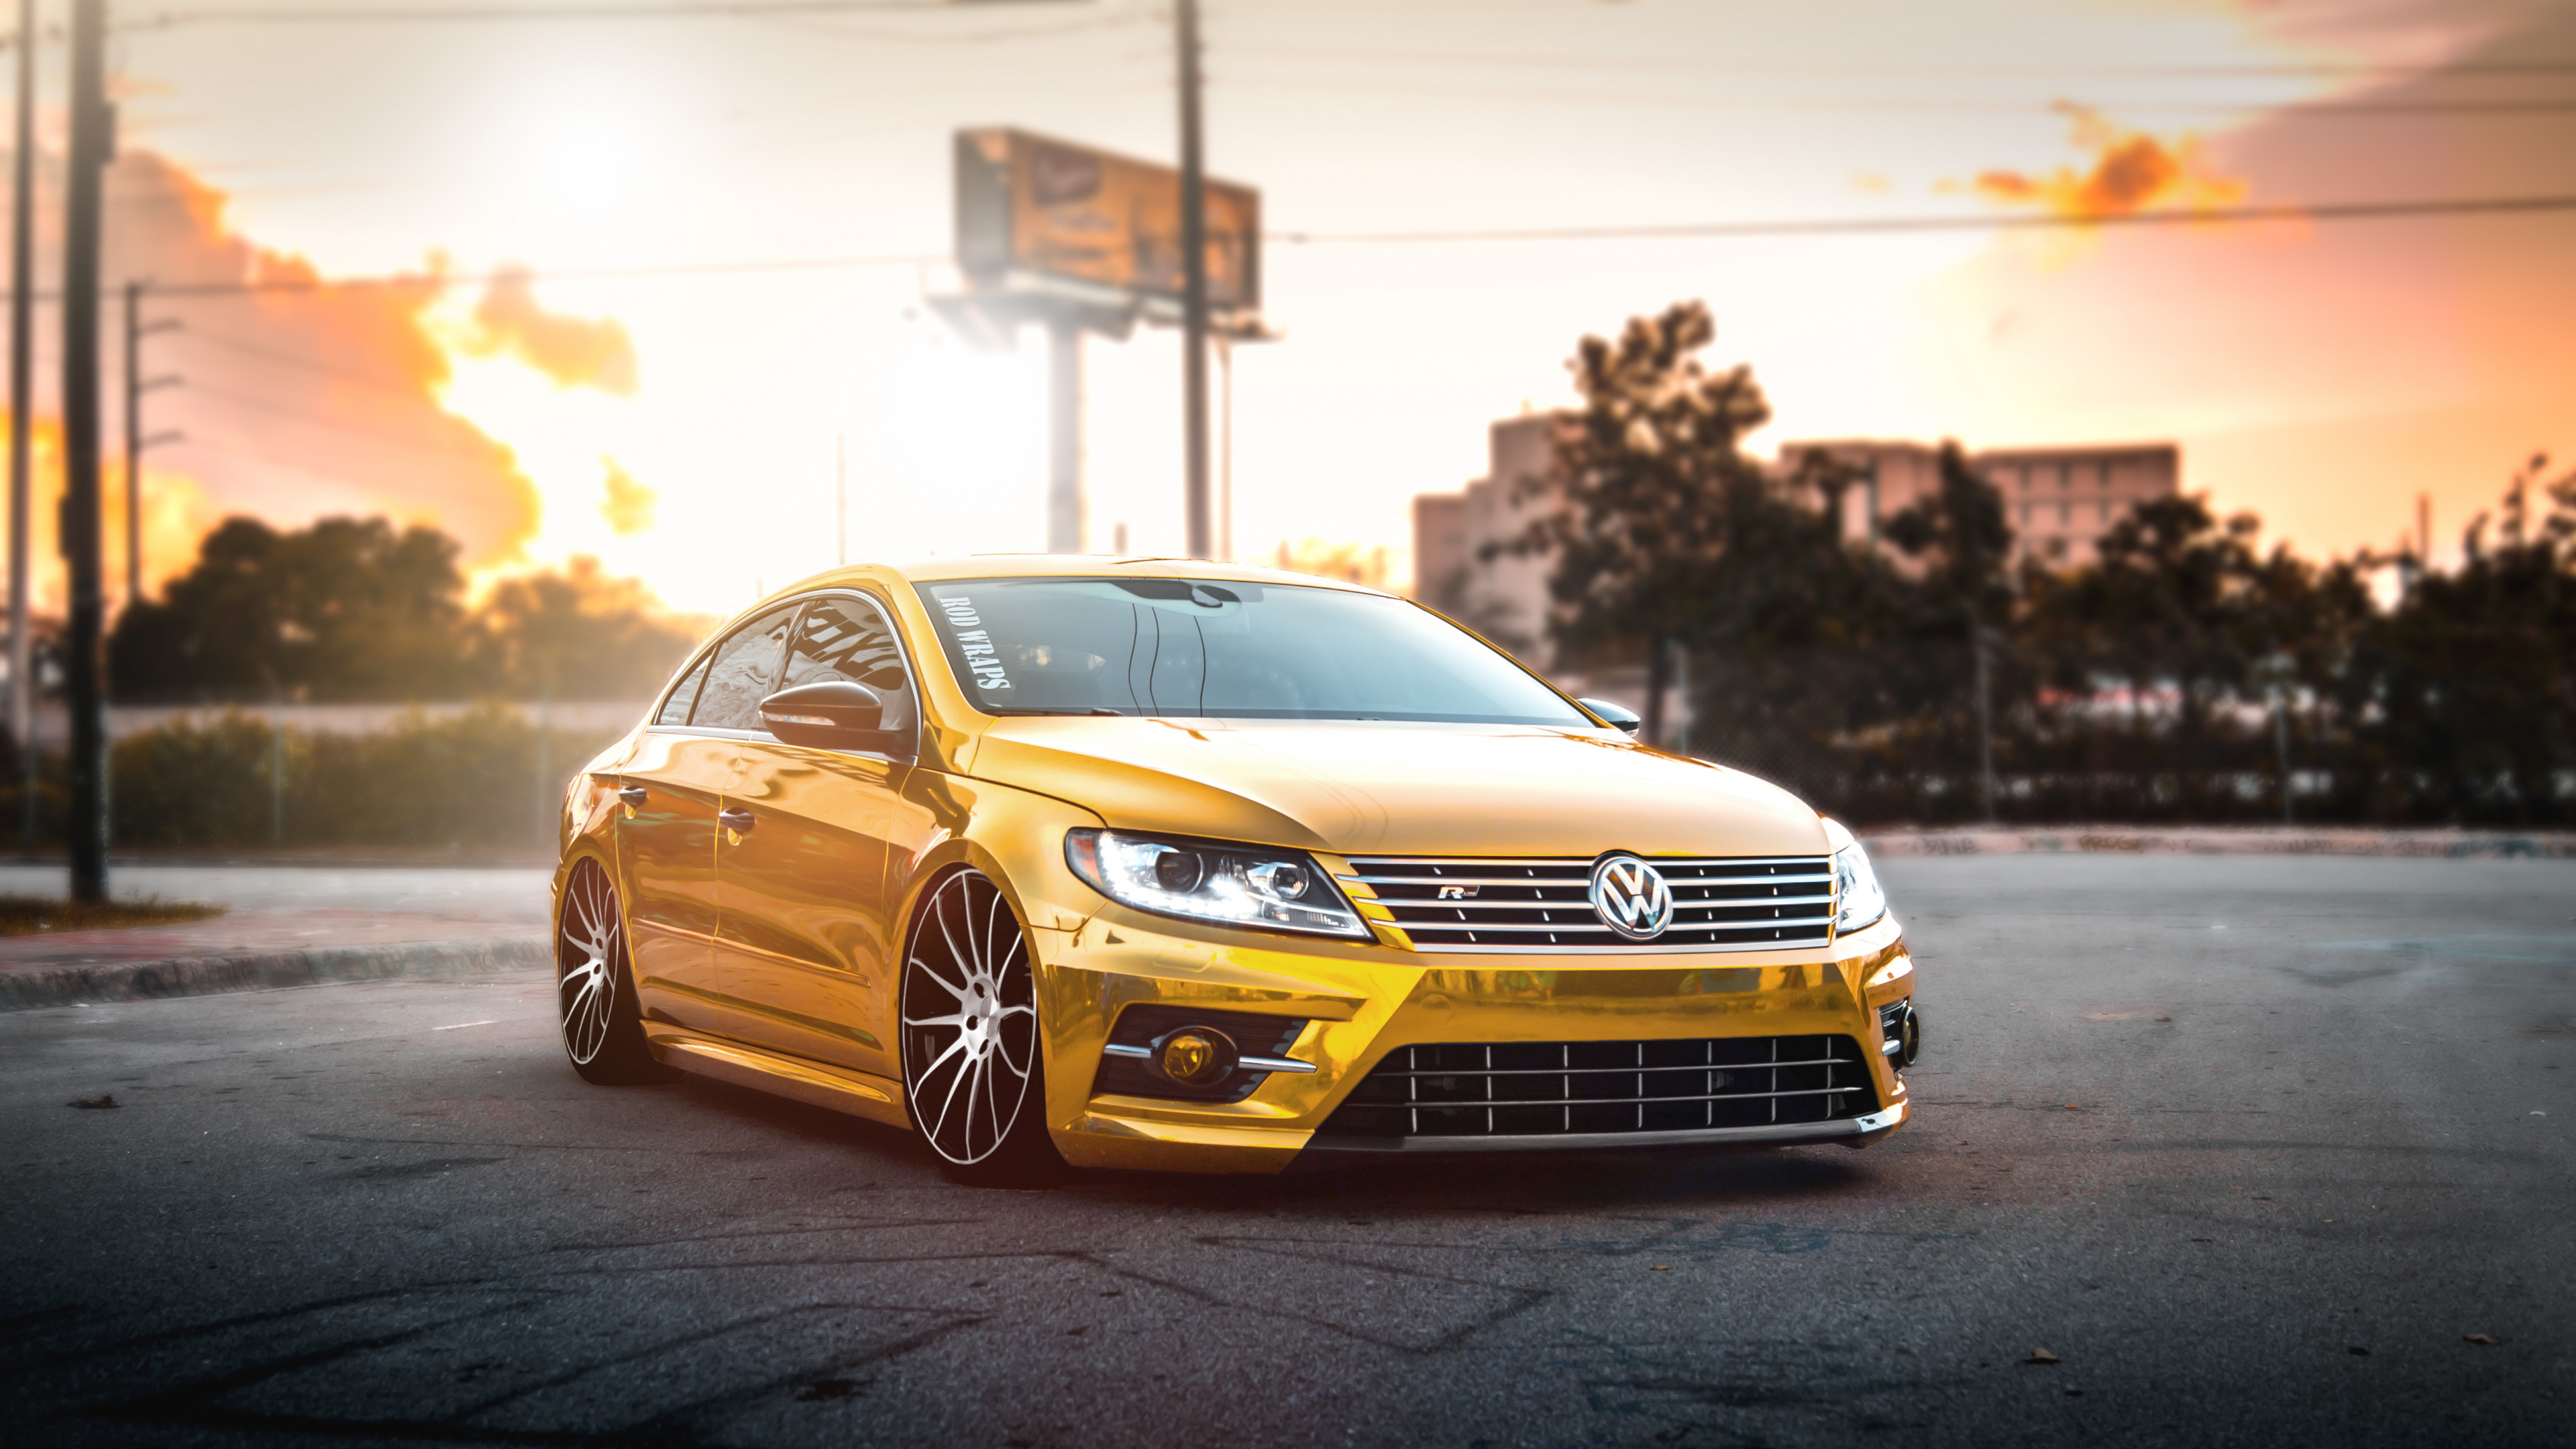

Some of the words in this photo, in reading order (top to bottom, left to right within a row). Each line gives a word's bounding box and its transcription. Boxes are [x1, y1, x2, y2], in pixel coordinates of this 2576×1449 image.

[939, 597, 981, 627] ROD
[957, 630, 1011, 690] WRAPS
[1438, 886, 1464, 899] R
[1599, 861, 1666, 933] VW
